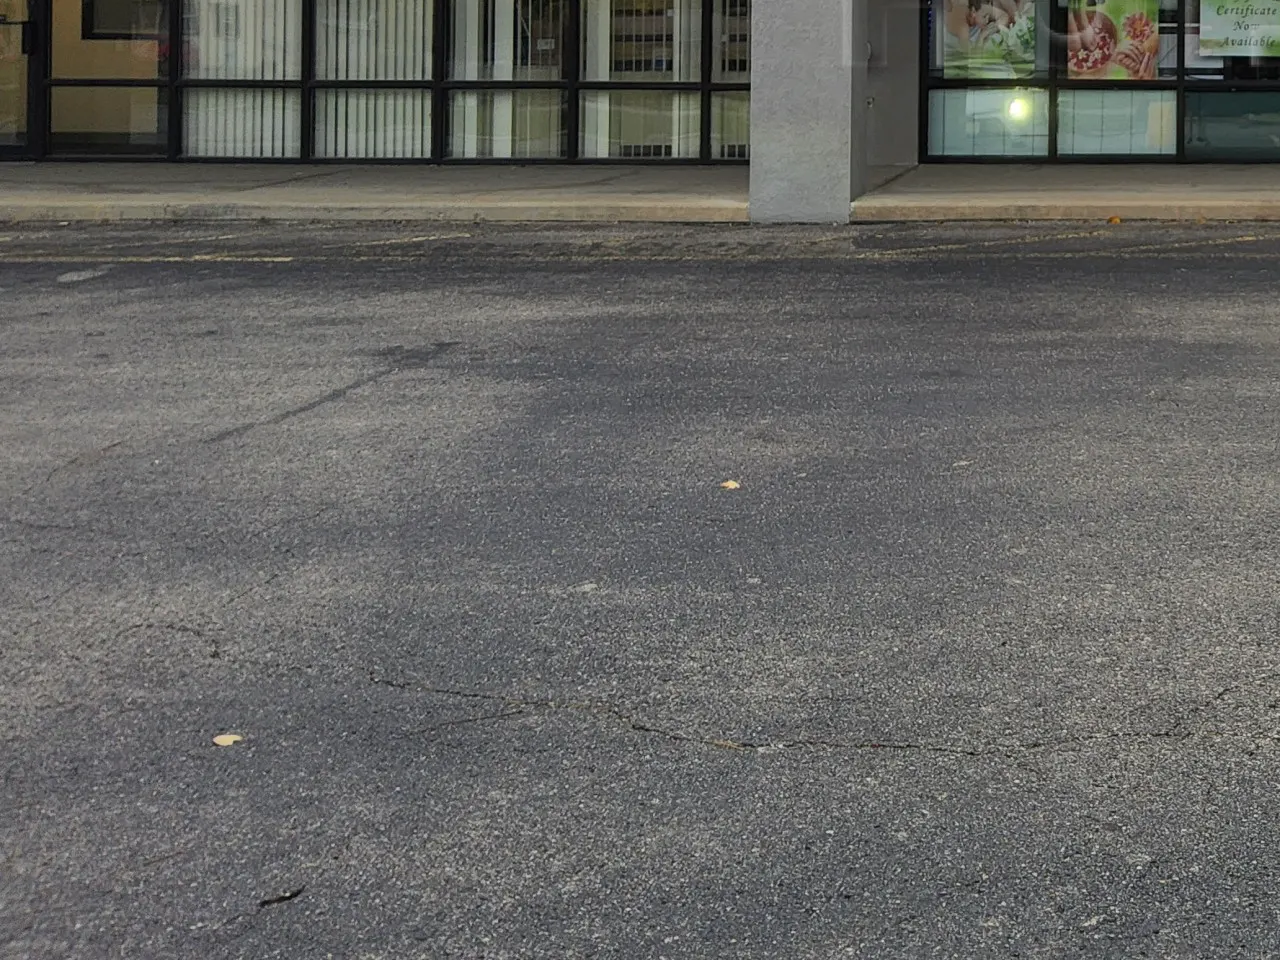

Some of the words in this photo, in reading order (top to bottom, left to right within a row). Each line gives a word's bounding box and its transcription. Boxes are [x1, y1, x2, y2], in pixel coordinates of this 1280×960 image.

[1216, 4, 1277, 18] Certificate
[1232, 21, 1260, 32] Now
[1220, 36, 1277, 49] Available
